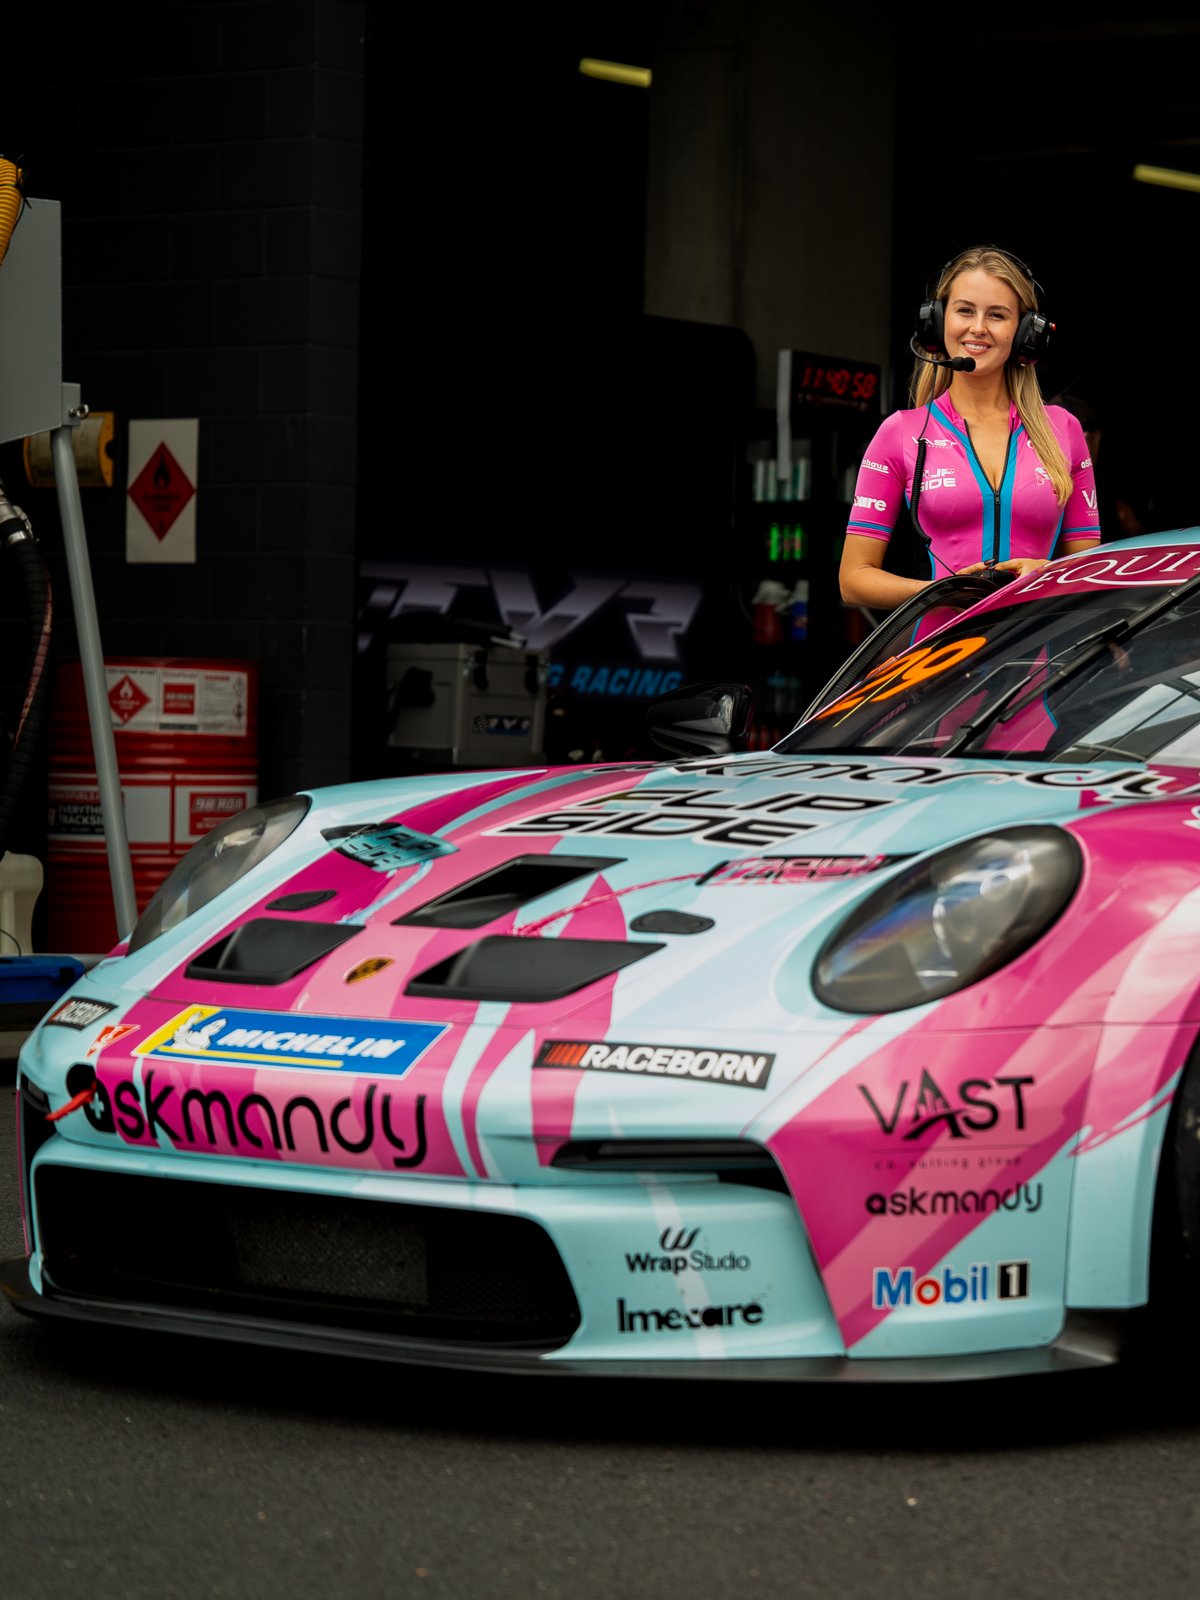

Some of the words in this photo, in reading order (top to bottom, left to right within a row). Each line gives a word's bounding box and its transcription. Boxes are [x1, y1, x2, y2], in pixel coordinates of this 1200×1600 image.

[571, 665, 683, 698] RACING
[566, 787, 898, 814] FLIP
[482, 810, 826, 848] SIDE
[217, 1027, 406, 1059] MICHELIN
[581, 1044, 768, 1084] RACEBORN
[66, 1068, 428, 1168] askmandy
[857, 1067, 1036, 1141] VAST
[865, 1182, 1043, 1217] askmandy
[874, 1264, 989, 1309] Mobil
[1005, 1264, 1022, 1297] 1
